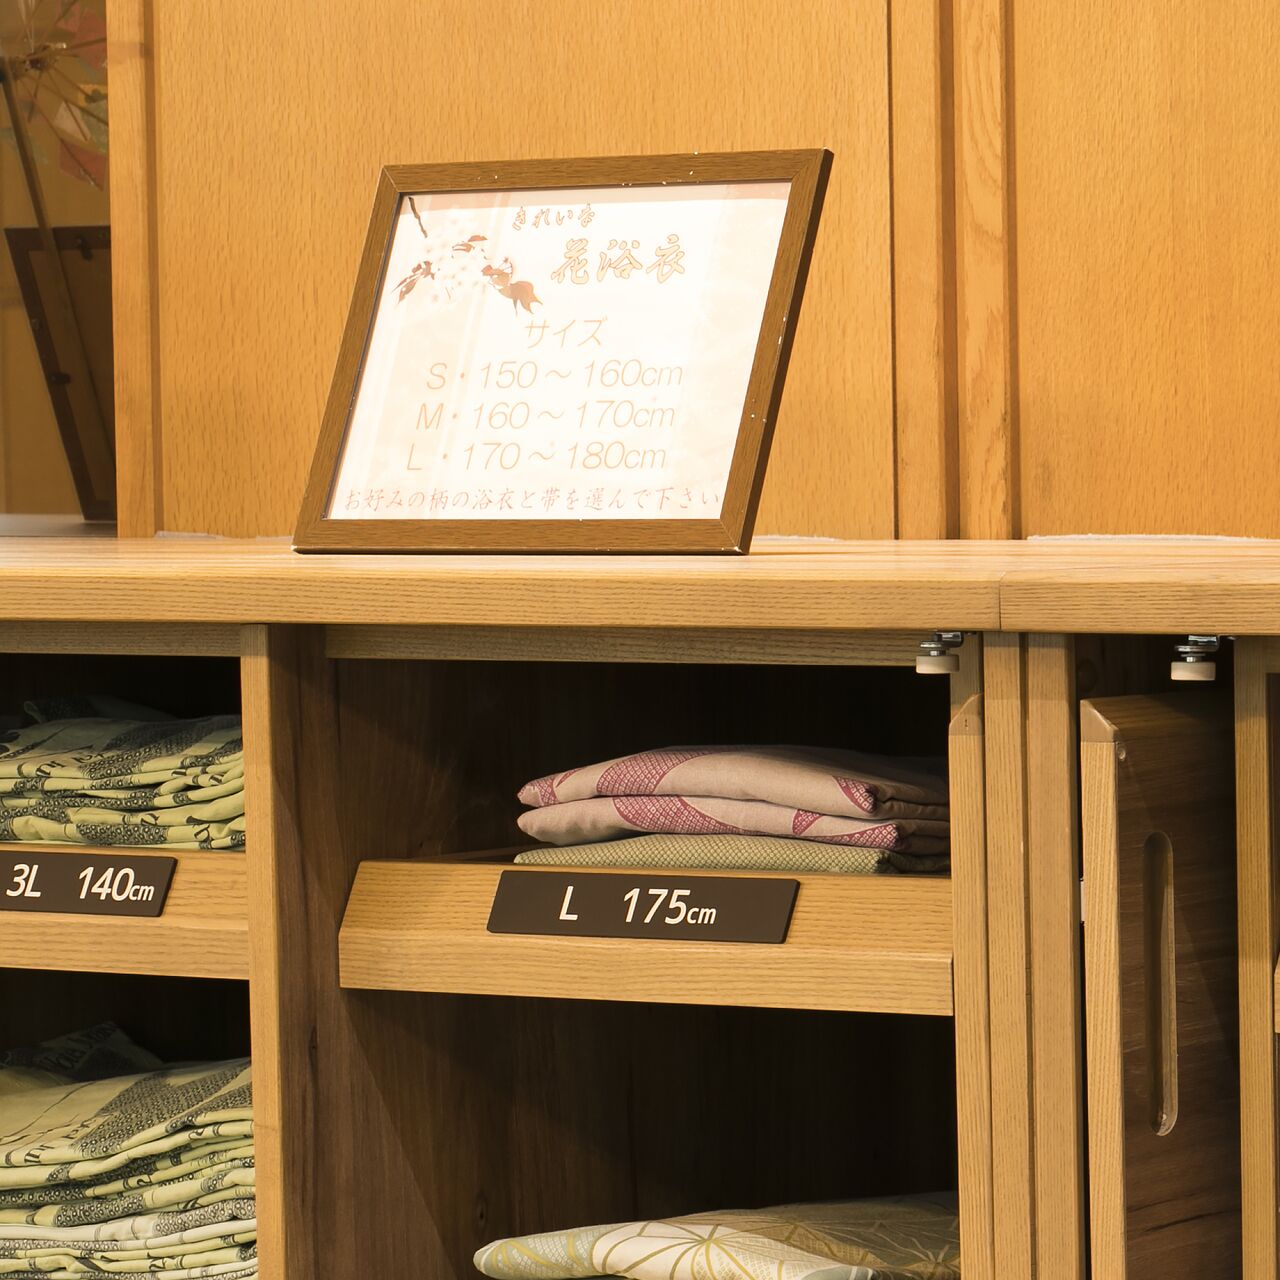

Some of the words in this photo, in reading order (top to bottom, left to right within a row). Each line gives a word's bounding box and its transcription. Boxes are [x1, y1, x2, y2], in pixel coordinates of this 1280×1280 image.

[511, 202, 596, 231] きれいな
[550, 234, 686, 285] 花浴衣
[524, 316, 608, 349] サイズ
[6, 863, 42, 898] 3L
[78, 866, 155, 901] 140cm
[559, 885, 579, 921] L
[623, 887, 717, 925] 175cm
